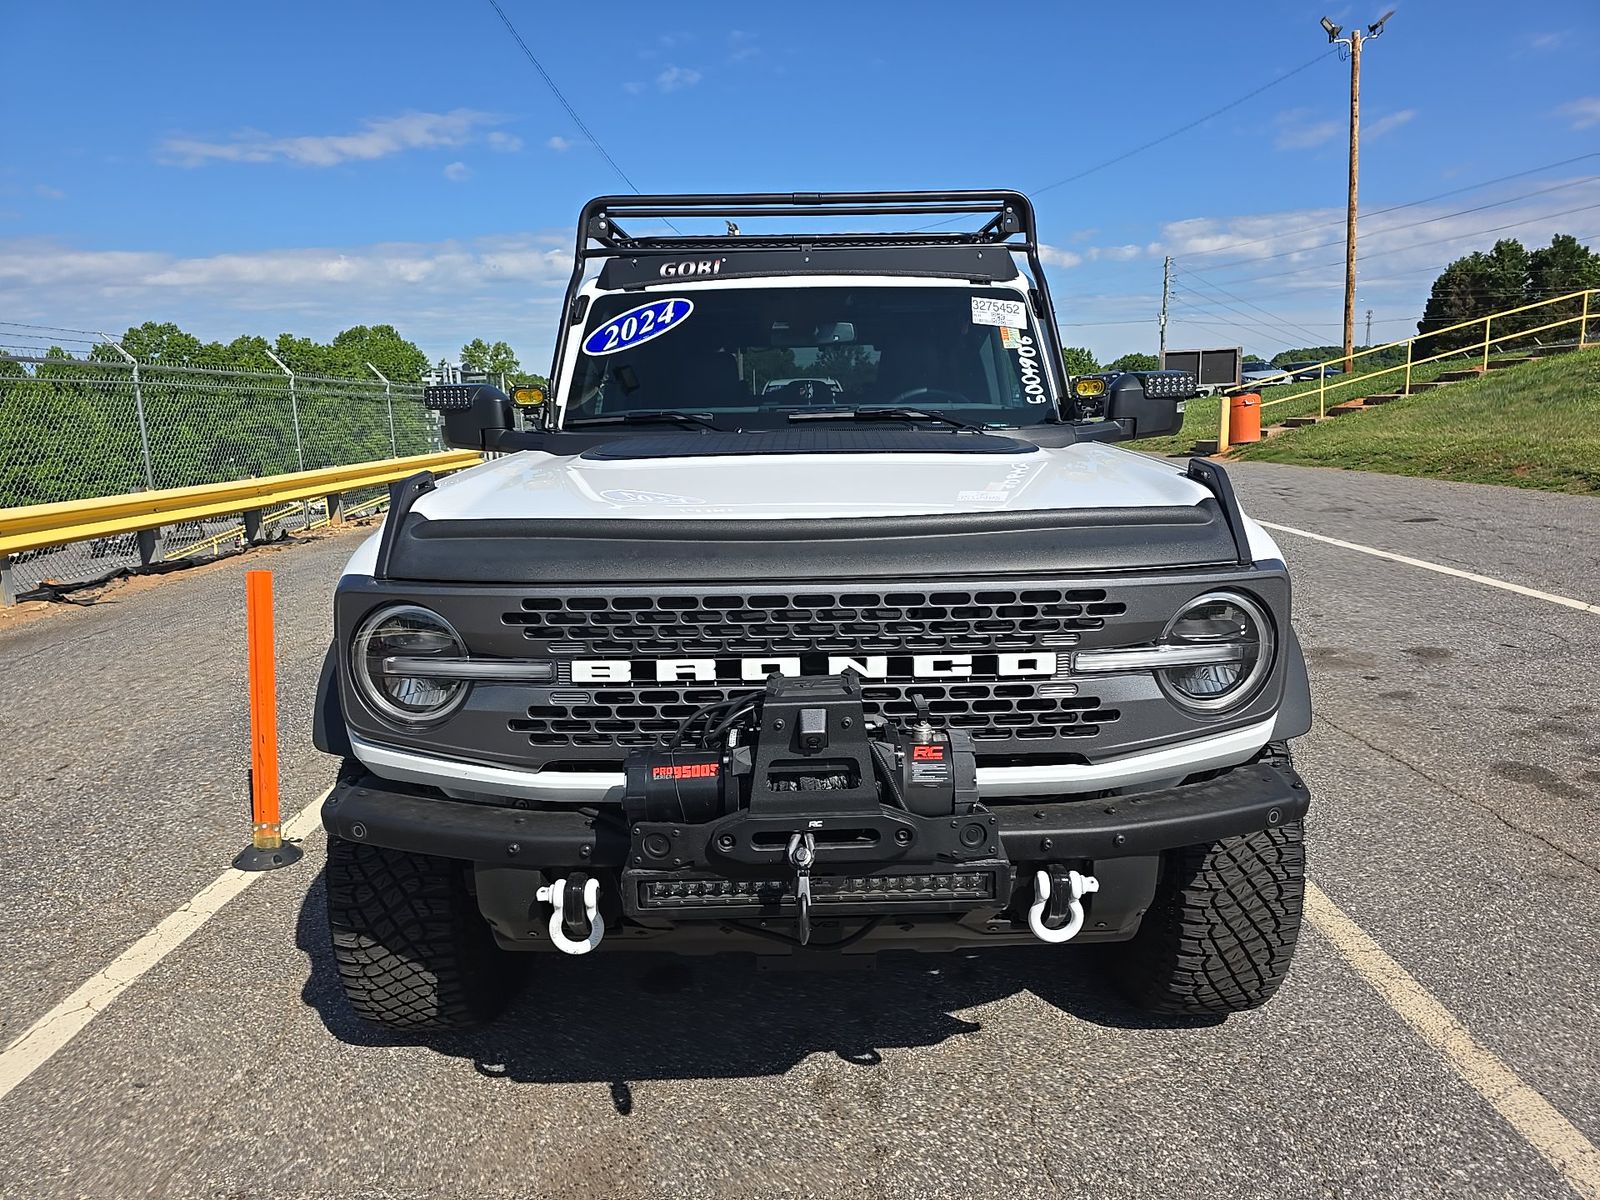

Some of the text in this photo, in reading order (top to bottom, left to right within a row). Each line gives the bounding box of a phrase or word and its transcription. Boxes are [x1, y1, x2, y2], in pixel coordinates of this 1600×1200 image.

[660, 260, 720, 278] GOBI
[972, 299, 1020, 315] 3275452
[603, 300, 675, 351] 2024
[1014, 336, 1047, 404] 5004906
[571, 653, 1057, 683] BRONCO
[914, 746, 944, 758] RC
[808, 820, 823, 828] RC
